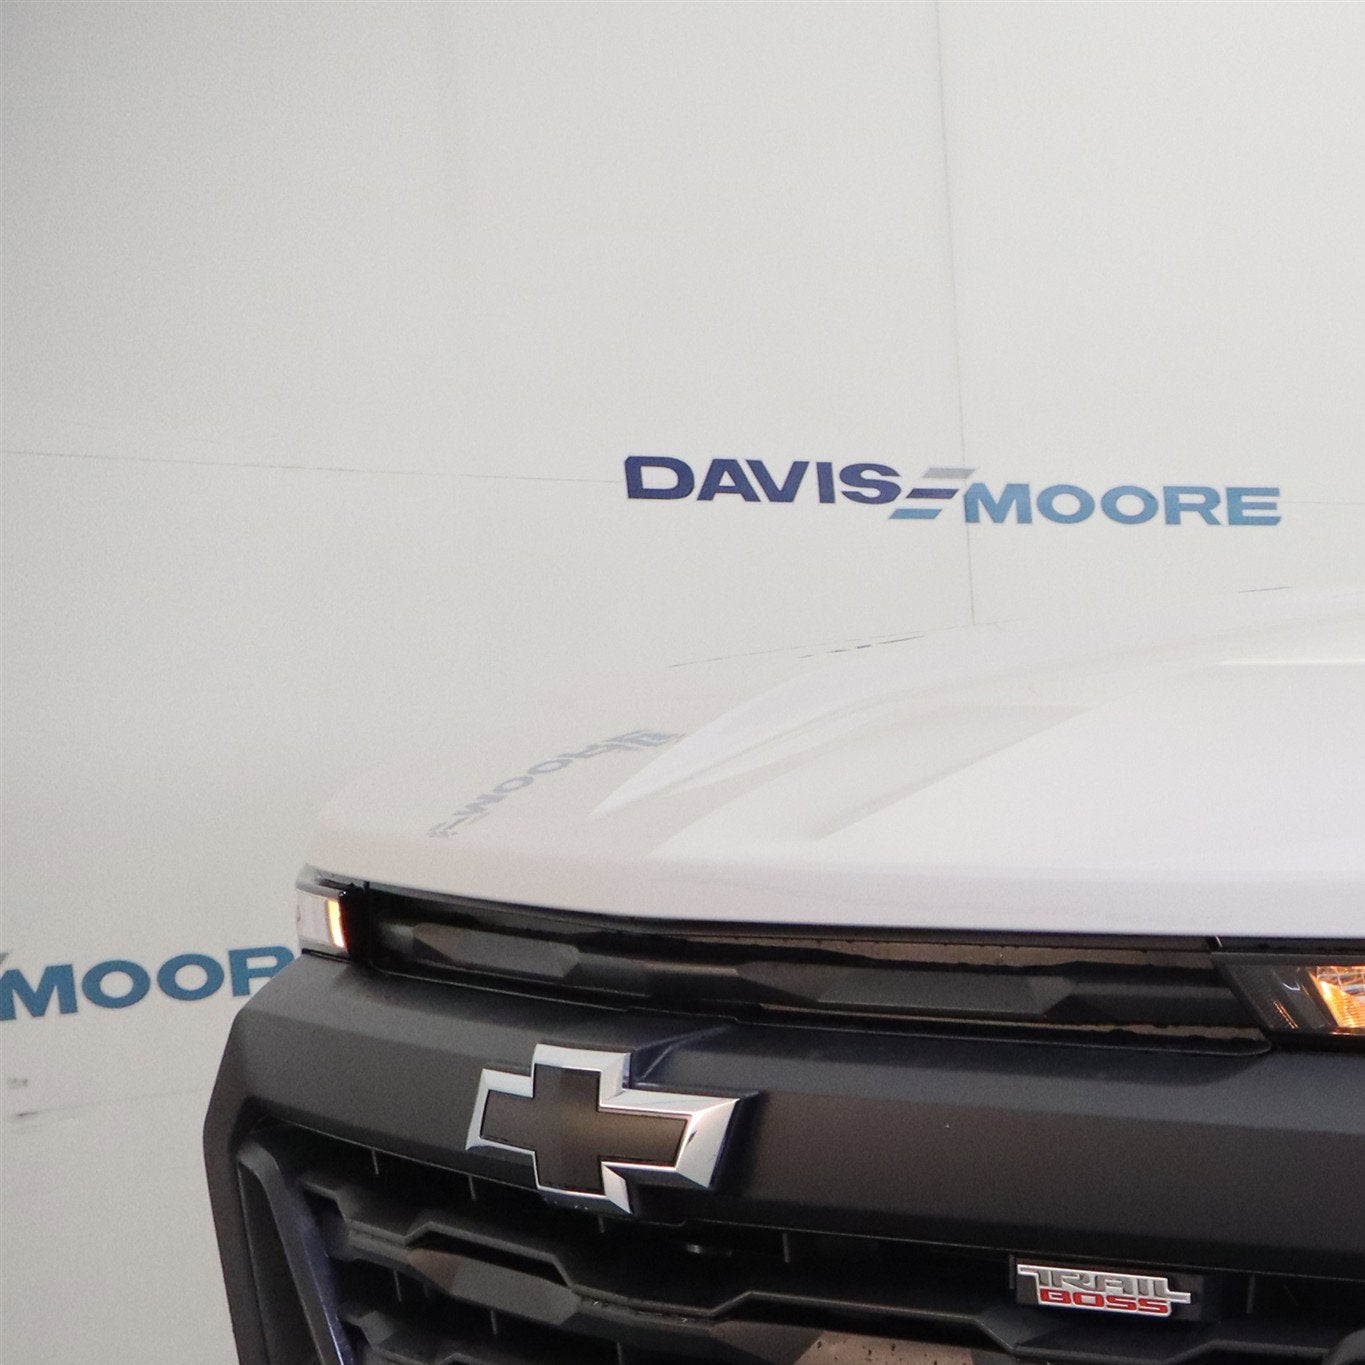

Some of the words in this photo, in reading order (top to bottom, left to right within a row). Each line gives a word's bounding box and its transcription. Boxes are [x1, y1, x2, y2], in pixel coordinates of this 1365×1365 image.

[624, 455, 902, 505] DAVIS
[962, 481, 1282, 528] MOORE
[1016, 1263, 1192, 1305] TRAIL
[1039, 1288, 1172, 1317] BOSS
